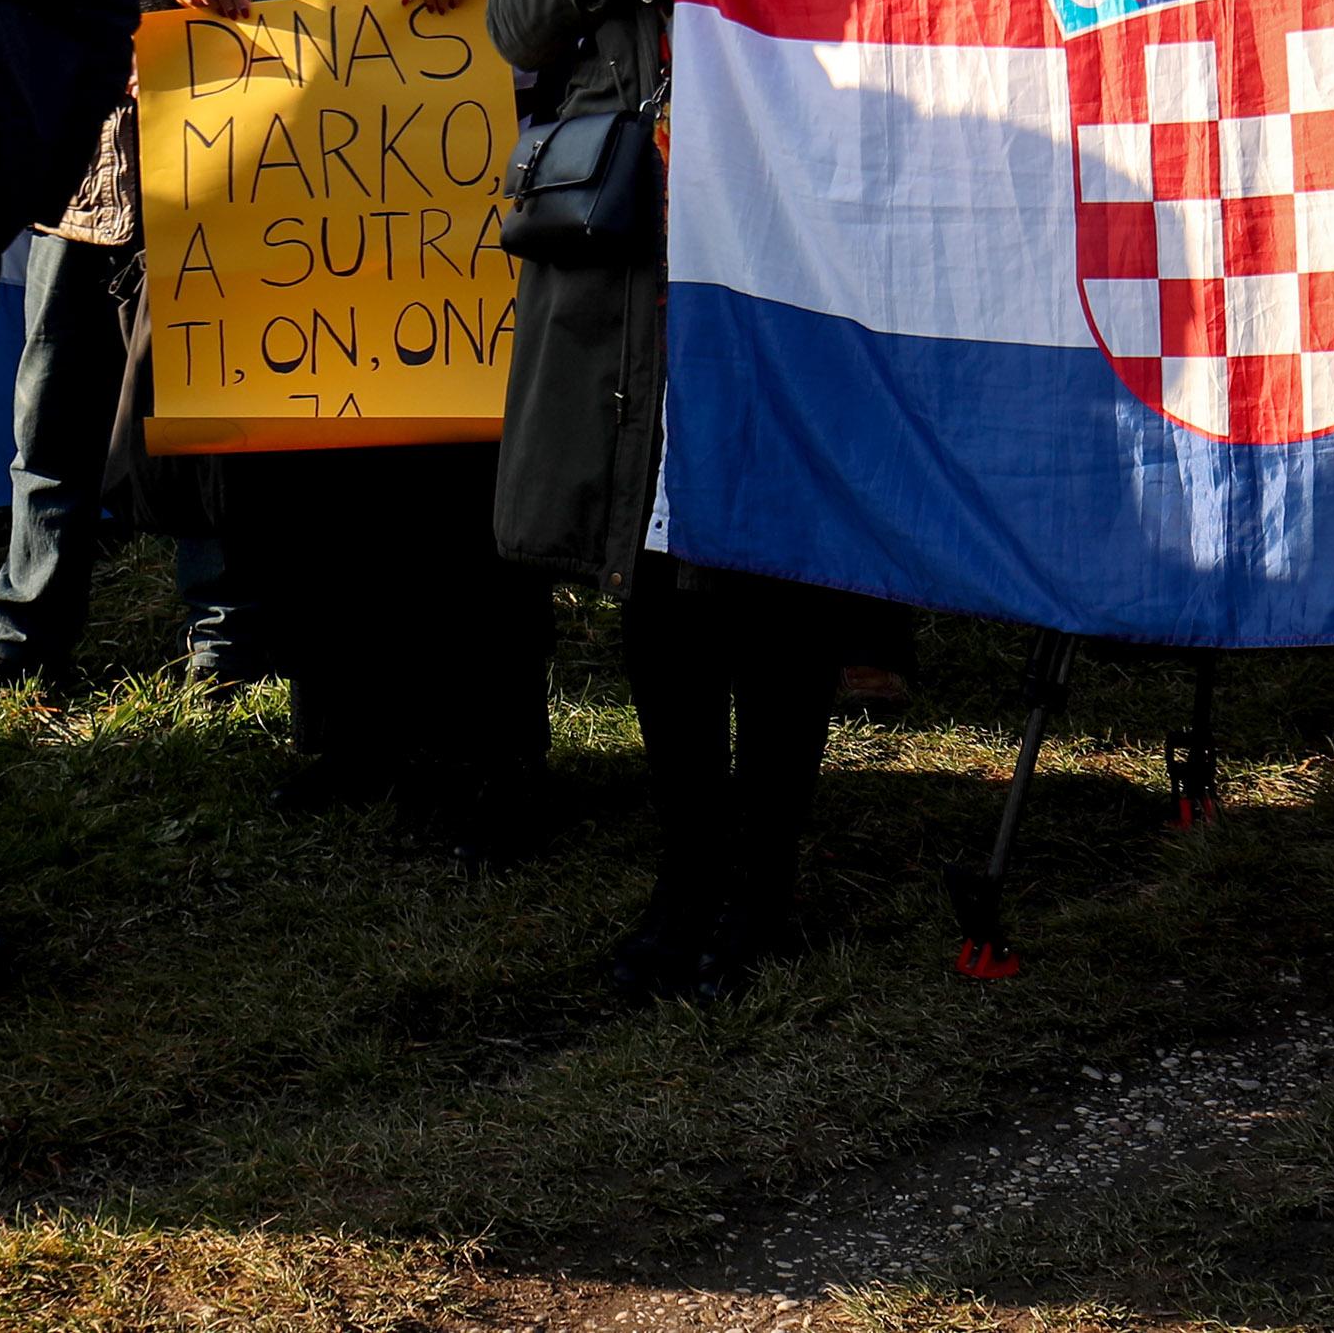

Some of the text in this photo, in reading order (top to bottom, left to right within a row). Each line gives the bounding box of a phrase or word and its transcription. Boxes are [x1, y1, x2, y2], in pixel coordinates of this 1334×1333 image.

[185, 2, 473, 99] DANAS
[183, 100, 500, 211] MARKO,
[174, 203, 515, 301] A SUTRA
